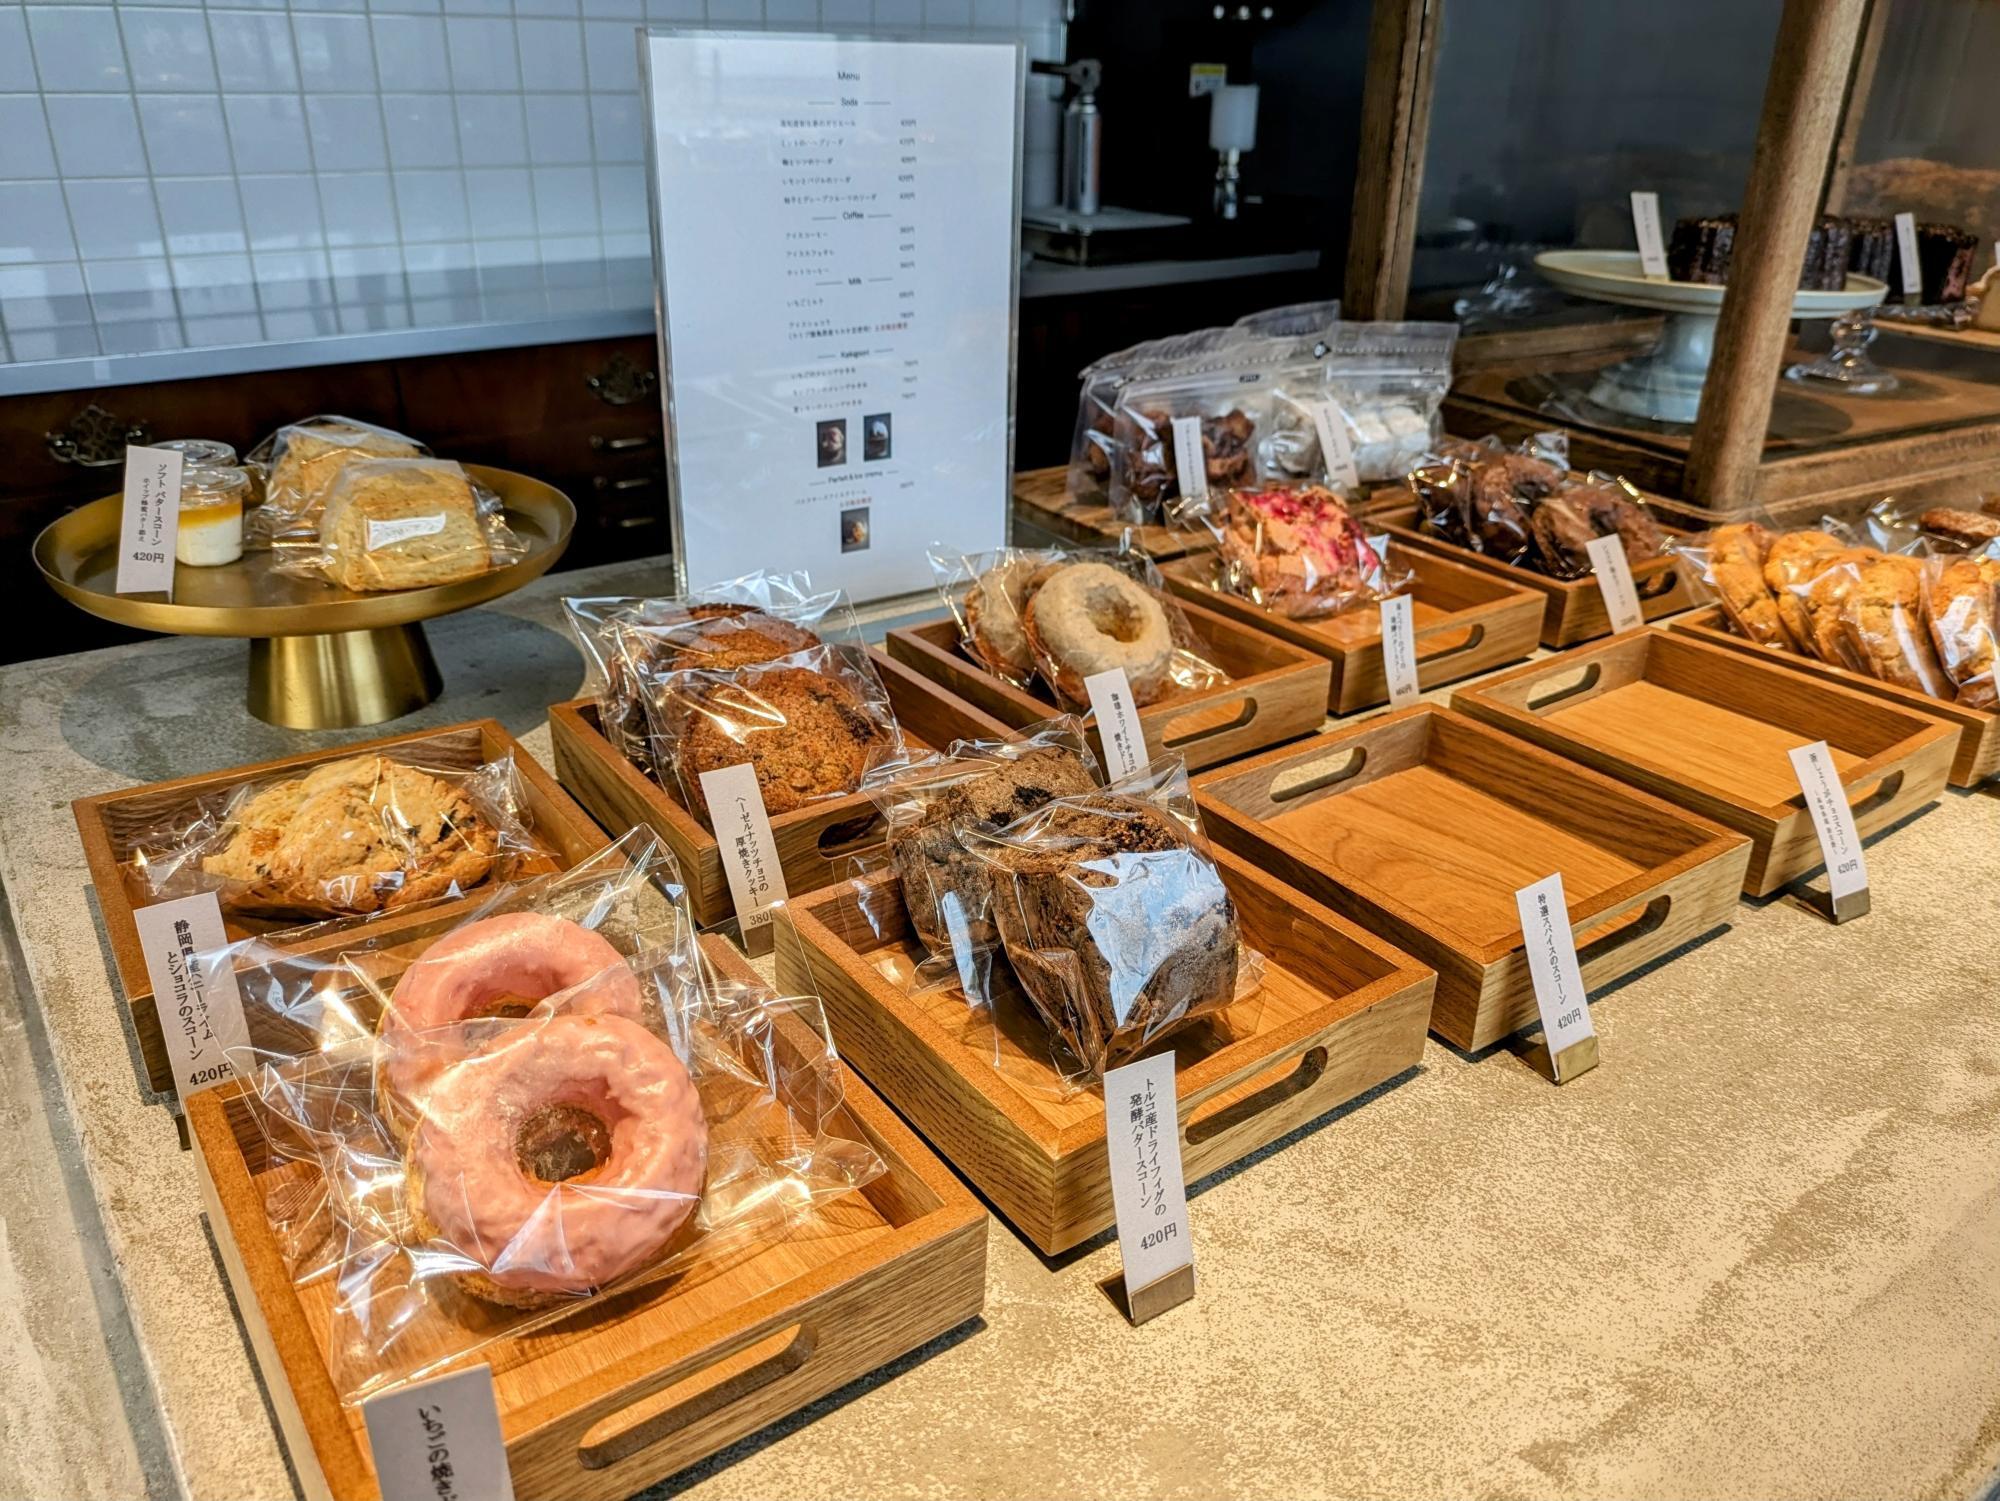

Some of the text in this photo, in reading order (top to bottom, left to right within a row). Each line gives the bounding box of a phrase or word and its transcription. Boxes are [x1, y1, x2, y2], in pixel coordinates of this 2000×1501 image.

[838, 71, 860, 80] Menu
[841, 97, 858, 106] Soda
[842, 211, 864, 221] Coffee
[848, 277, 862, 286] Milk
[132, 551, 165, 563] 420円
[735, 796, 769, 892] ヘーゼルナッツチョコの
[735, 837, 760, 907] 厚焼きクッキー
[1837, 859, 1859, 875] 420円
[1537, 893, 1567, 1005] 特選スパイスのスコーン
[167, 951, 204, 1061] とショコラのスコーン
[1557, 1007, 1582, 1030] 420円
[189, 1062, 233, 1086] 420円
[1130, 1093, 1151, 1209] 発酵バタースコーン
[1143, 1078, 1167, 1216] トルコ産ドライフィグの
[1140, 1222, 1178, 1250] 420円
